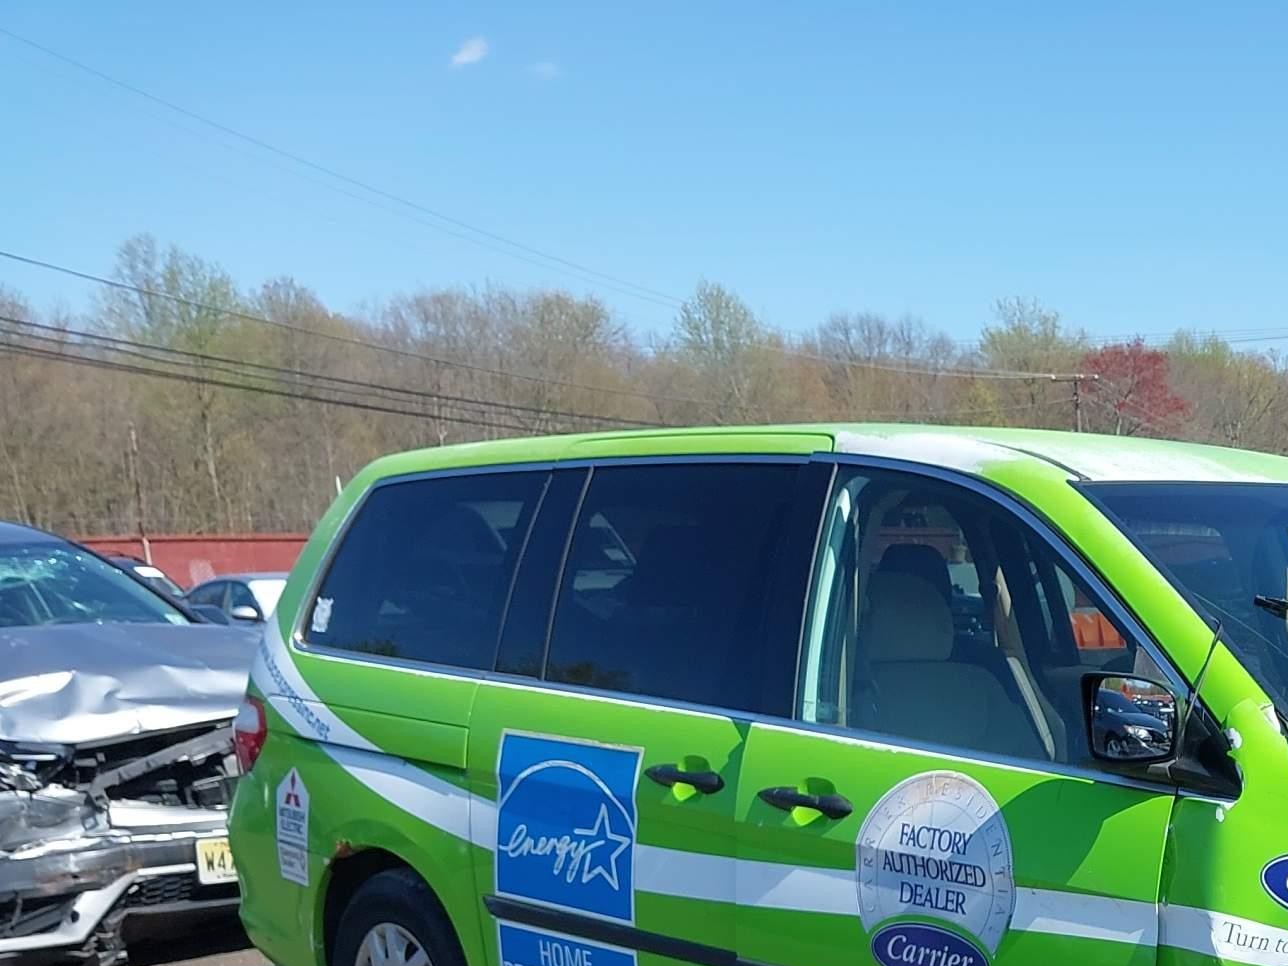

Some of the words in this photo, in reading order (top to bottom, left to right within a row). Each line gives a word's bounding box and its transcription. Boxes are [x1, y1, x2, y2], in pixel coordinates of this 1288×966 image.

[499, 824, 600, 883] energy
[899, 823, 974, 856] FACTORY
[883, 850, 986, 888] AUTHORIZED
[899, 881, 967, 916] DEALER
[1223, 920, 1270, 951] Turn
